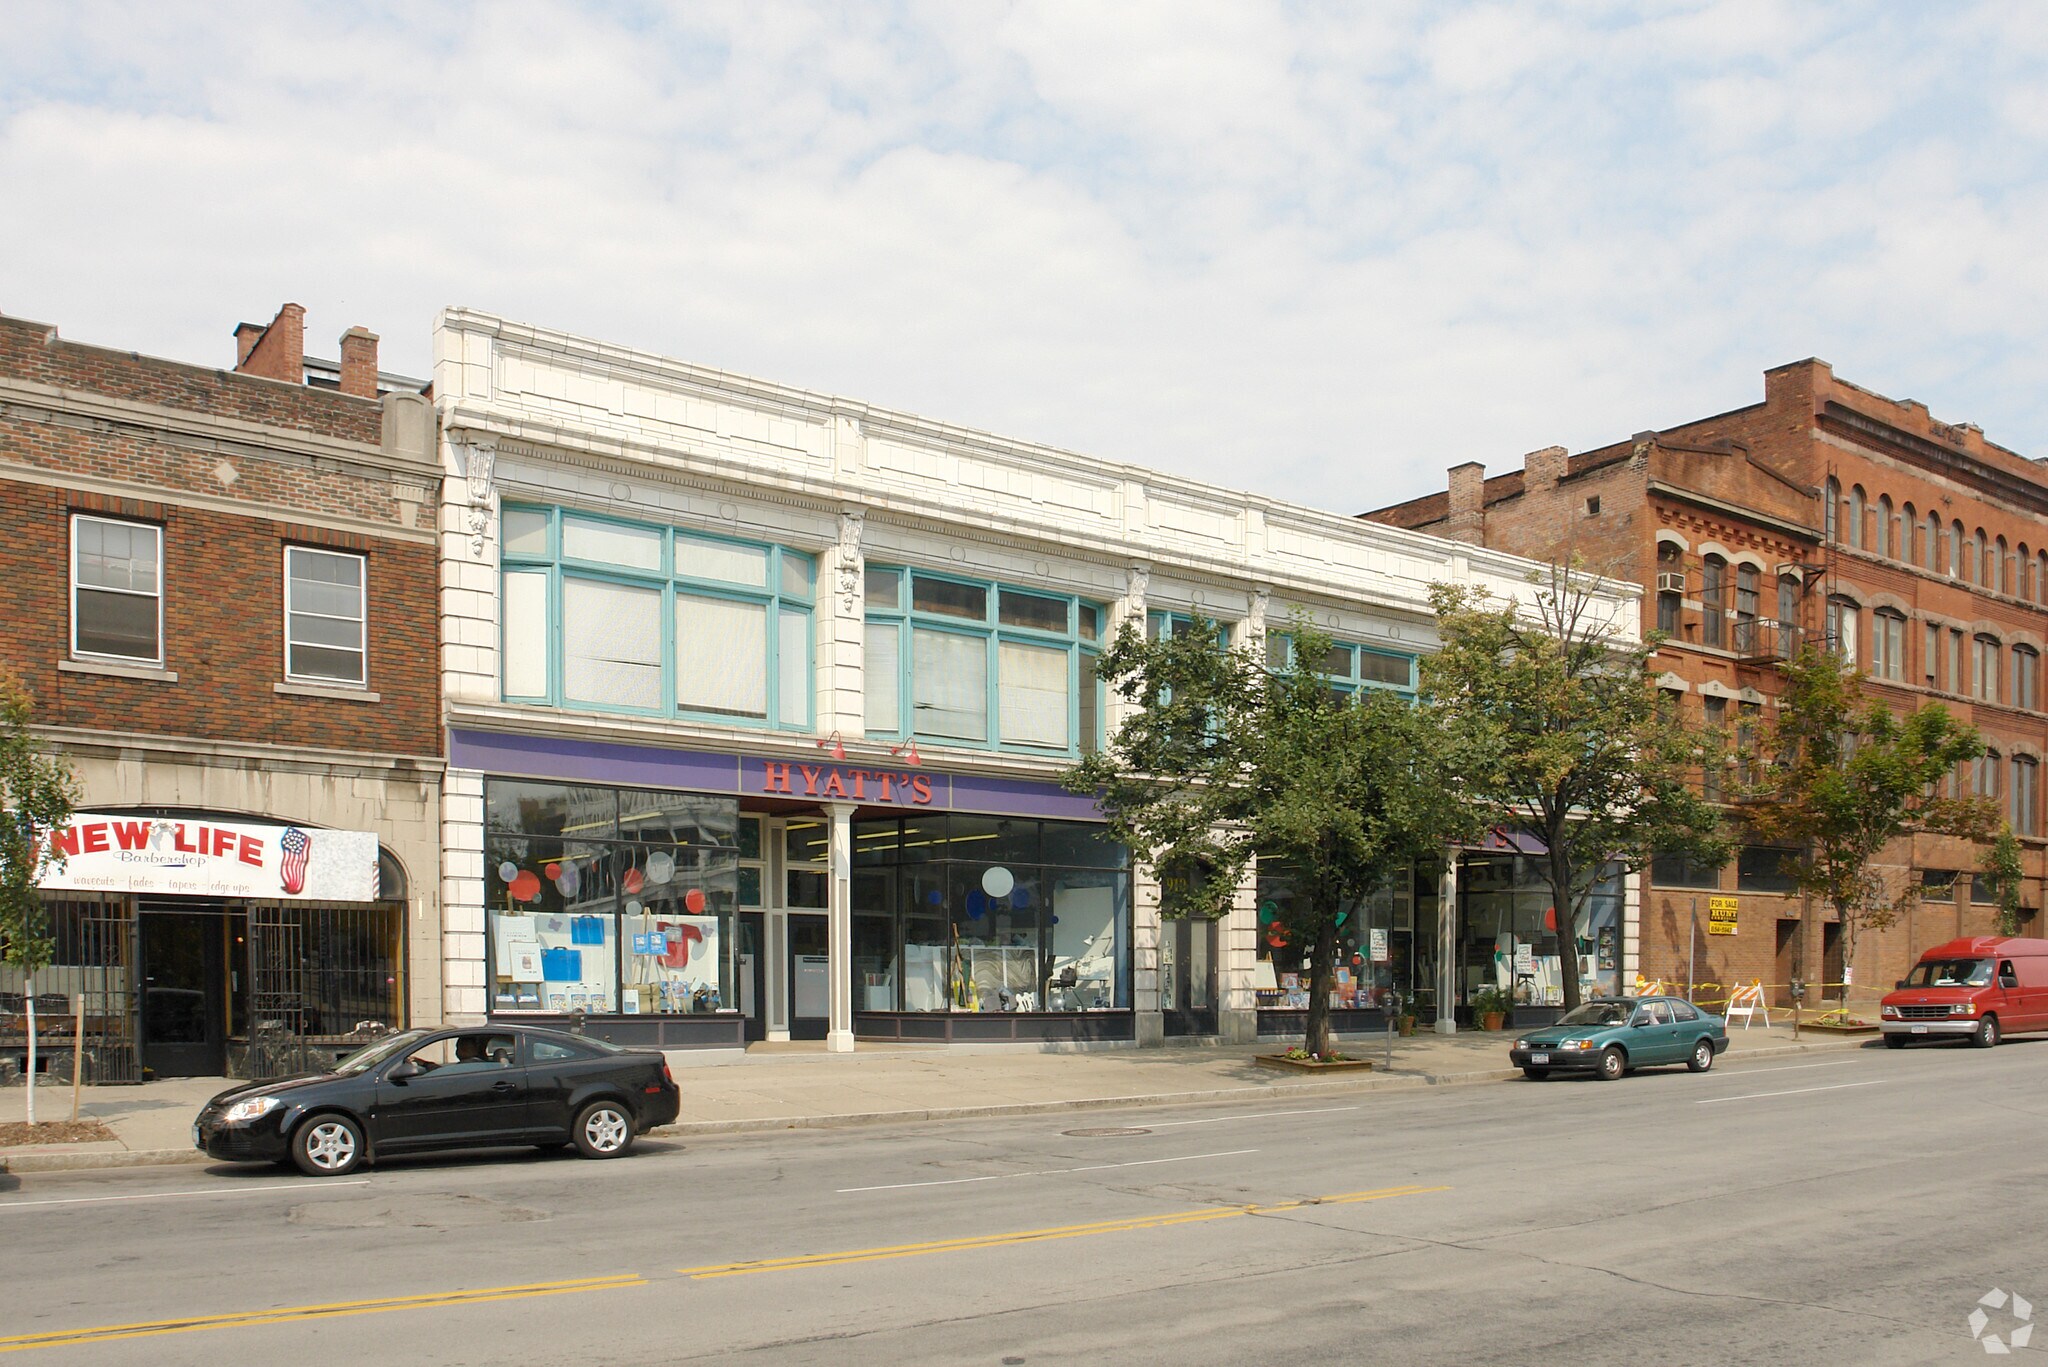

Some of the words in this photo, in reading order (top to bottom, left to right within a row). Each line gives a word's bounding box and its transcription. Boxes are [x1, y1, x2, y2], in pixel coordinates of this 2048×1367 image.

[763, 762, 932, 804] HYATT'S
[49, 821, 152, 856] NEW
[174, 822, 264, 868] LIFE
[112, 850, 207, 869] Barbershop
[73, 875, 115, 887] wavecuts
[128, 875, 155, 890] fades
[168, 878, 198, 892] tapers
[210, 878, 230, 893] edge
[1724, 900, 1737, 908] SALE
